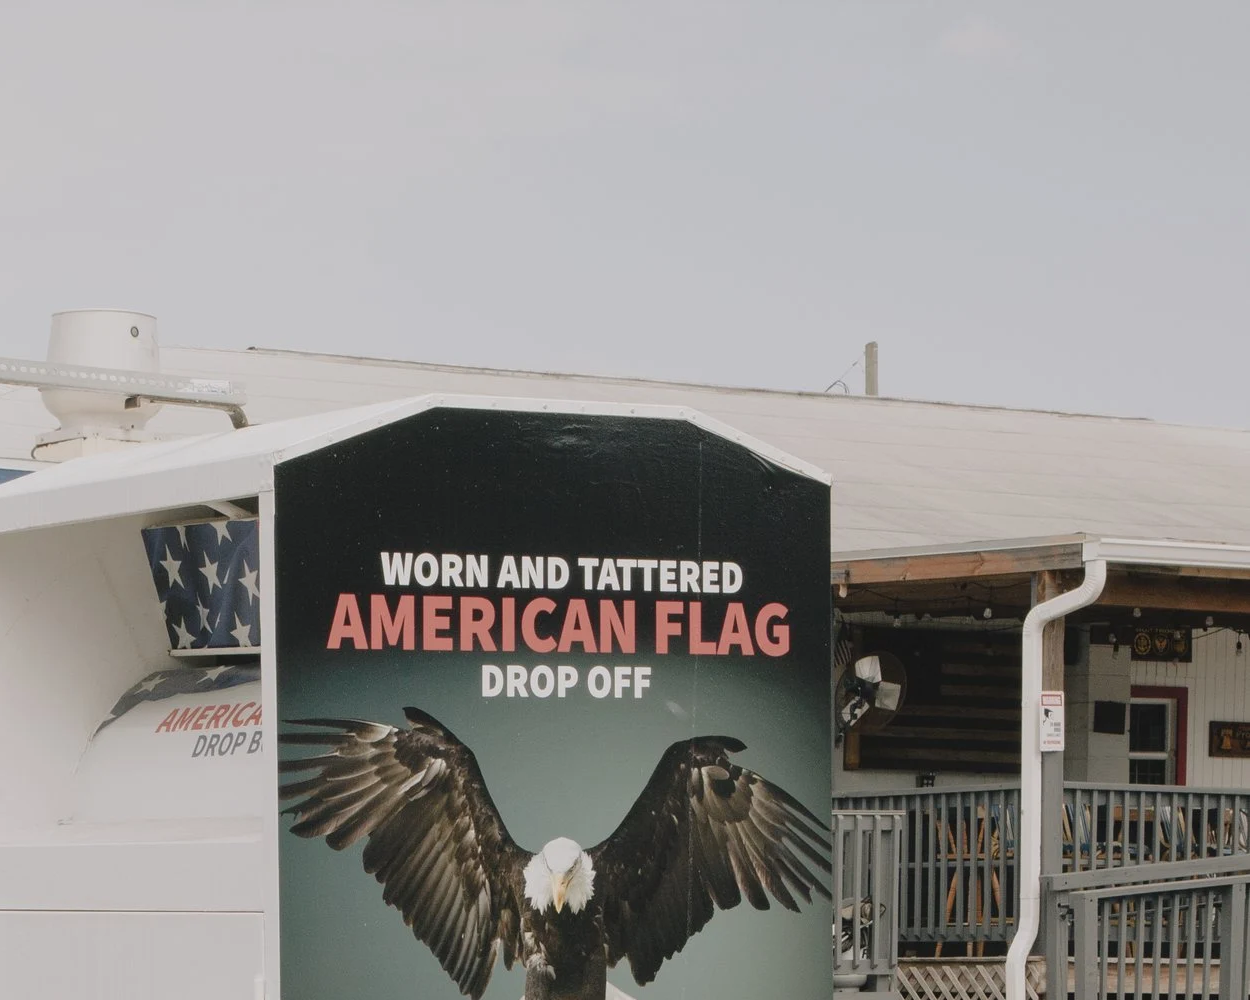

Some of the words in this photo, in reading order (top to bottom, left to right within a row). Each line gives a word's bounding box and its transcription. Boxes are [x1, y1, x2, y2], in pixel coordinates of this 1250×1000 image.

[380, 551, 488, 589] WORN
[496, 555, 570, 590] AND
[578, 557, 743, 595] TATTERED
[326, 593, 636, 655] AMERICAN
[655, 600, 790, 657] FLAG
[481, 664, 578, 698] DROP
[587, 665, 652, 699] OFF
[154, 701, 262, 734] AMERICA
[191, 731, 247, 758] DROP
[247, 730, 263, 755] B
